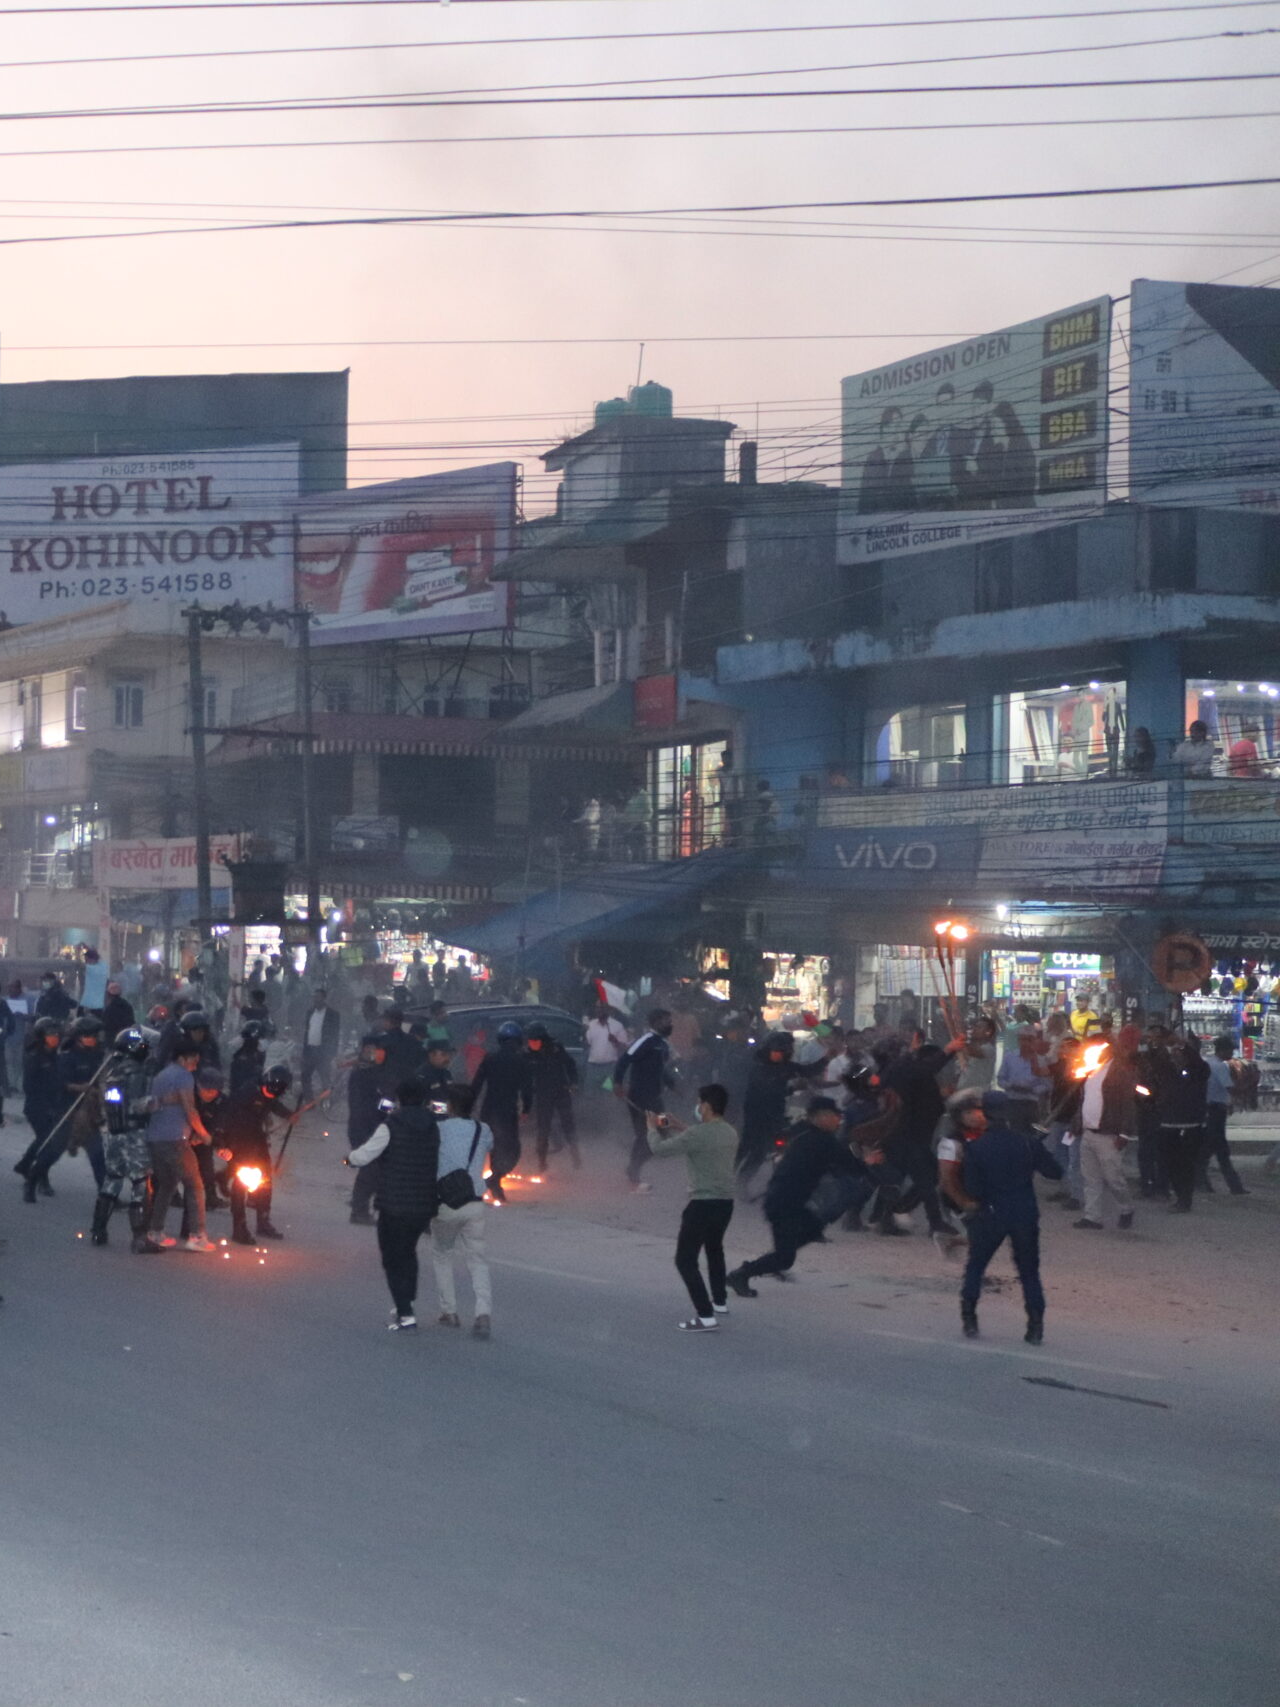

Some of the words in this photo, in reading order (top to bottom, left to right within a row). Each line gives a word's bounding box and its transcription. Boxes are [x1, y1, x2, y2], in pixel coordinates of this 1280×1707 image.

[1049, 311, 1093, 351] BHM
[860, 349, 957, 398] ADMISSION
[961, 333, 1011, 366] OPEN
[1053, 362, 1086, 397] BIT
[1048, 410, 1087, 444] BBA
[51, 475, 232, 520] HOTEL
[10, 521, 276, 572] KOHINOOR
[866, 534, 910, 554] LINCOLN
[912, 526, 962, 546] COLLEGE
